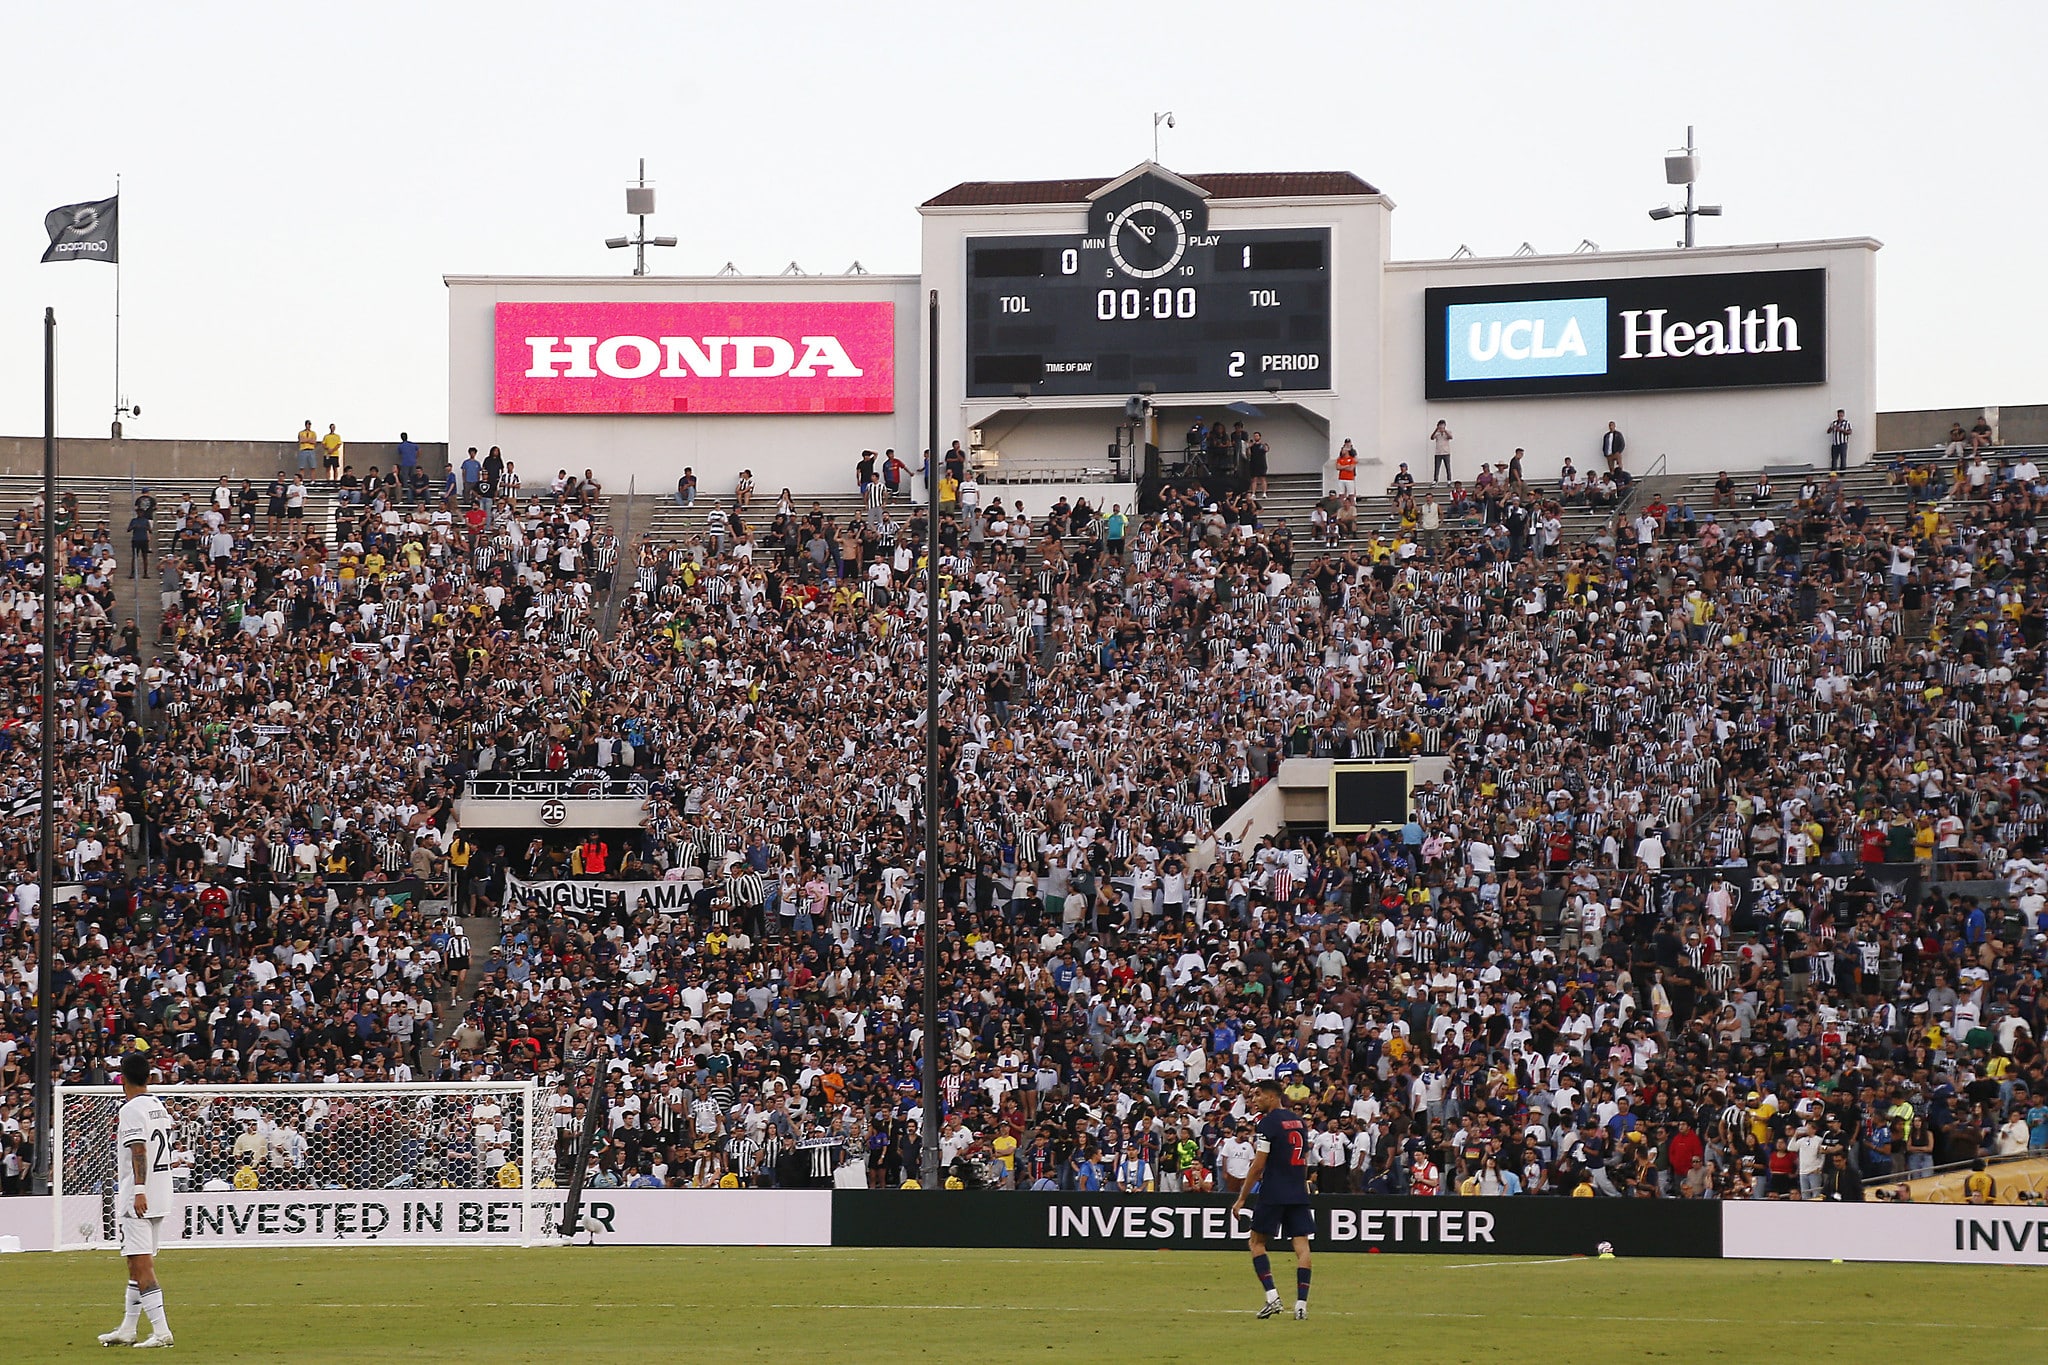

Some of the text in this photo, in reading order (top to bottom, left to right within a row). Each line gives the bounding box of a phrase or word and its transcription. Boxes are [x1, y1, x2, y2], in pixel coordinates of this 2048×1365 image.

[1107, 213, 1114, 222] 0
[1180, 210, 1193, 220] 15
[1141, 226, 1156, 236] TO
[1083, 239, 1106, 249] MIN
[1190, 236, 1220, 246] PLAY
[1062, 249, 1077, 274] 0
[1242, 246, 1250, 268] 1
[1107, 268, 1114, 278] 5
[1180, 266, 1194, 276] 10
[1001, 296, 1030, 313] TOL
[1097, 288, 1196, 320] 00:00
[1250, 290, 1280, 307] TOL
[1470, 317, 1587, 361] UCLA
[1620, 303, 1801, 359] Health
[525, 336, 863, 378] HONDA
[1228, 352, 1245, 378] 2
[1262, 354, 1319, 371] PERIOD
[1045, 362, 1093, 372] TIME OF DAY
[542, 804, 566, 820] 26
[184, 1203, 390, 1236] INVESTED
[403, 1202, 443, 1232] IN
[1049, 1205, 1254, 1238] INVESTED
[1331, 1209, 1495, 1243] BETTER
